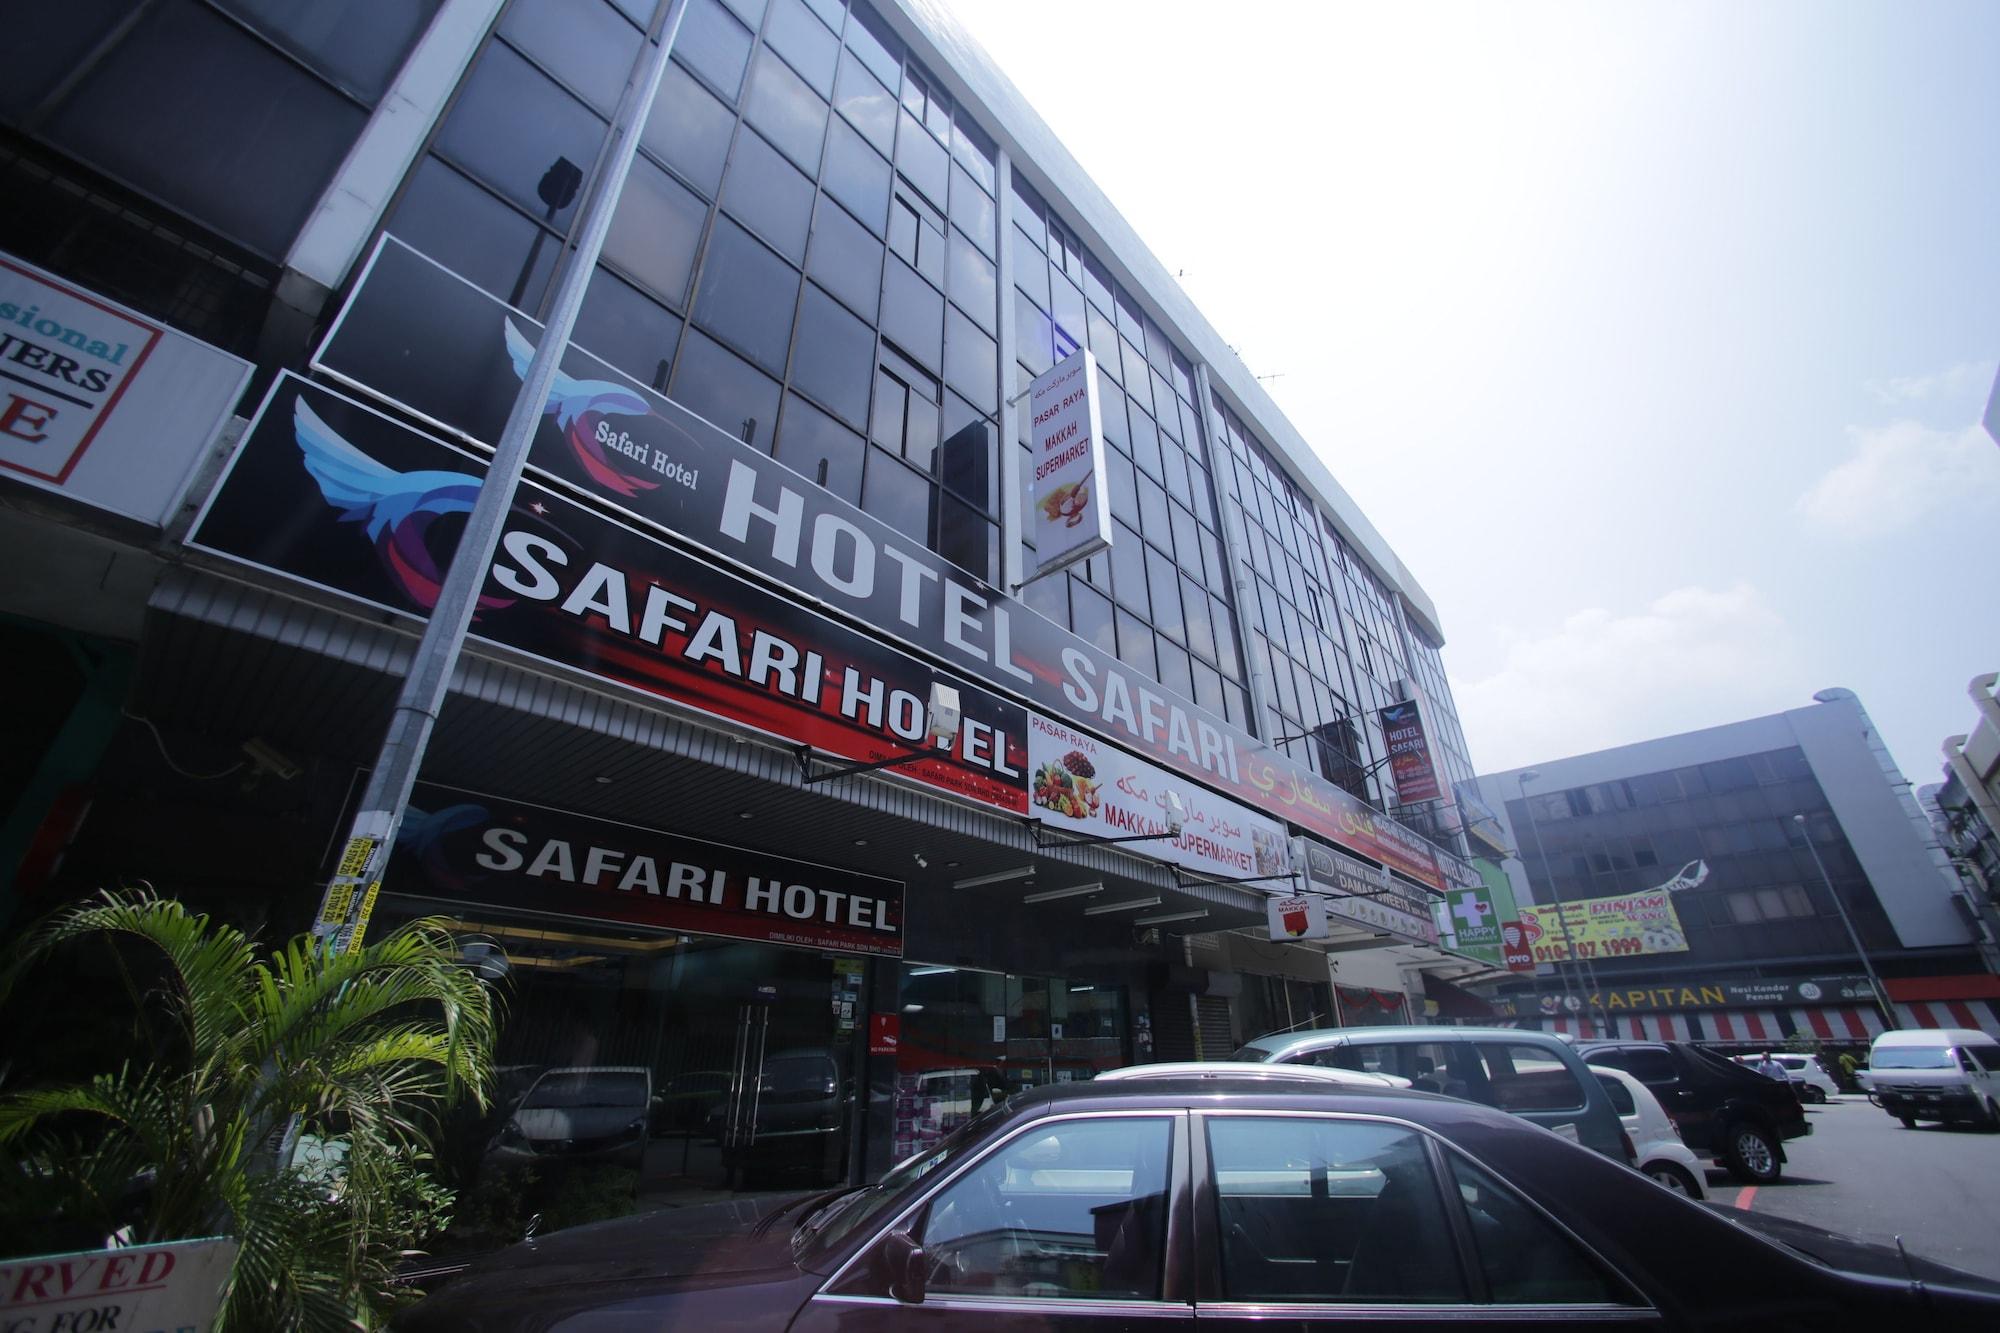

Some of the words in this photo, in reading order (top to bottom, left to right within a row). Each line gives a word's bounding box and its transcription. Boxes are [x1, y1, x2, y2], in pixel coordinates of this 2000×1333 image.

[1034, 404, 1060, 428] PASAR
[1063, 387, 1085, 409] RAYA
[1045, 420, 1077, 452] MAKKAH
[595, 419, 651, 466] Safari
[651, 448, 699, 490] Hotel
[1036, 438, 1089, 480] SUPERMARKET
[719, 458, 1034, 685] HOTEL
[1062, 646, 1240, 785] SAFARI
[493, 530, 824, 705] SAFARI
[841, 667, 1019, 779] HOEL
[1032, 716, 1067, 741] PASAR
[1071, 734, 1097, 754] RAYA
[1389, 727, 1419, 742] HOTEL
[1391, 739, 1424, 753] SAFARI
[1155, 788, 1205, 824] مارت
[1105, 802, 1165, 844] MAKKAH
[1171, 830, 1253, 872] SUPERMARKET
[476, 826, 726, 905] SAFARI
[745, 876, 897, 933] HOTEL
[1589, 895, 1667, 914] PINJAM
[1625, 911, 1669, 922] WANG
[796, 935, 813, 944] OLEH
[818, 938, 839, 947] SAFARI
[840, 940, 856, 950] PARK
[1460, 926, 1496, 938] HAPPY
[1601, 936, 1643, 956] 1999
[1508, 954, 1530, 964] OYO
[1730, 985, 1751, 994] Nasi
[1753, 984, 1789, 993] Kandar
[1746, 993, 1783, 1001] Penang
[0, 1251, 176, 1301] RVED
[52, 1304, 122, 1333] FOR
